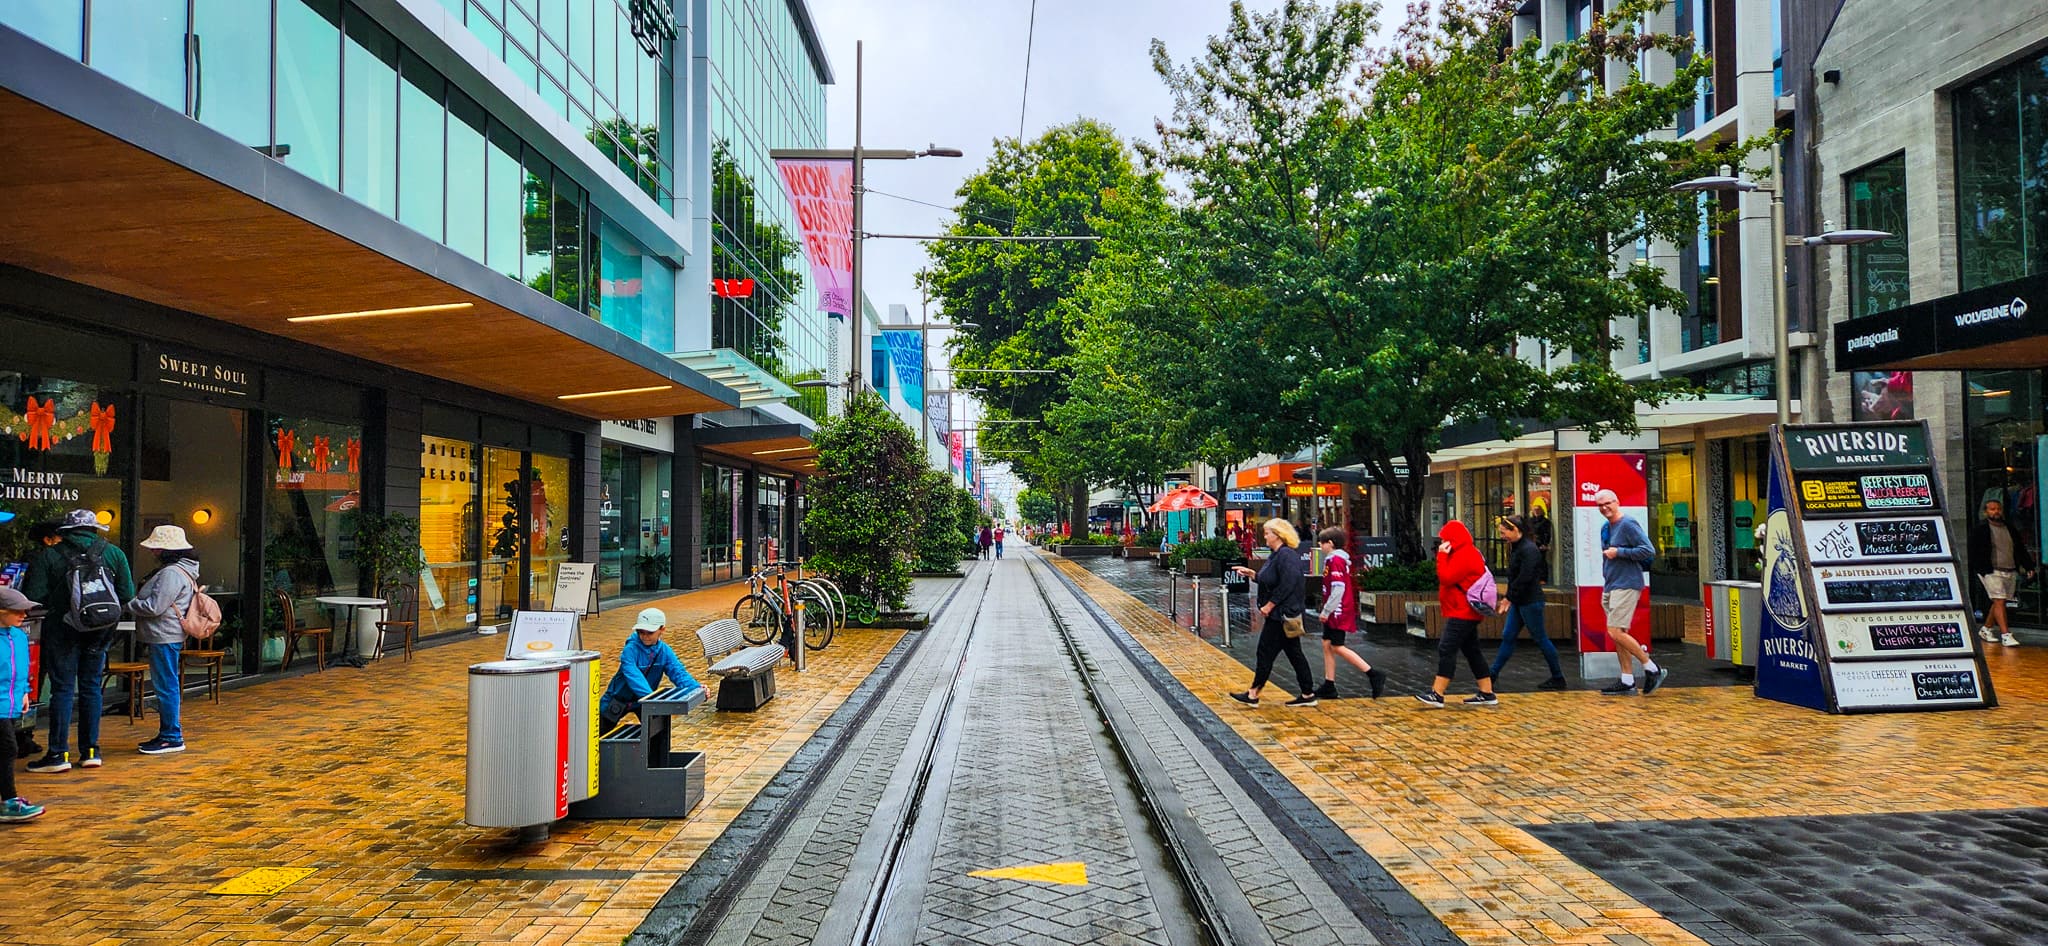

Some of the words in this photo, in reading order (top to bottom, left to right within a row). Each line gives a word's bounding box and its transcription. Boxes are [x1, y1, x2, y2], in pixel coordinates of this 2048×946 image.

[1954, 304, 2009, 327] WOLVERINE
[1847, 328, 1899, 352] patagonia
[159, 353, 208, 377] SWEET
[214, 364, 247, 385] SOUL
[183, 381, 226, 394] PATISSERIE
[1804, 431, 1908, 457] RIVERSIDE
[1835, 454, 1885, 463] MARKET
[13, 467, 64, 485] MERRY
[1863, 477, 1884, 488] BEER
[1884, 476, 1903, 487] FEST
[1581, 482, 1600, 492] City
[1581, 493, 1597, 501] Ma
[1899, 521, 1929, 532] Chips
[1814, 521, 1849, 552] LITTLE
[1872, 534, 1897, 543] FRESH
[1899, 533, 1920, 541] FISH
[1905, 542, 1938, 554] Oysters
[1223, 570, 1246, 584] SALE
[1835, 568, 1905, 578] MEDITERRANEAN
[1907, 567, 1933, 575] FOOD
[1732, 599, 1740, 652] Recycling
[1878, 636, 1917, 647] CHERRY
[1763, 637, 1818, 662] RIVERSID
[1779, 660, 1809, 671] MARKET
[1871, 669, 1908, 680] CHEESERY
[560, 760, 569, 811] Litter
